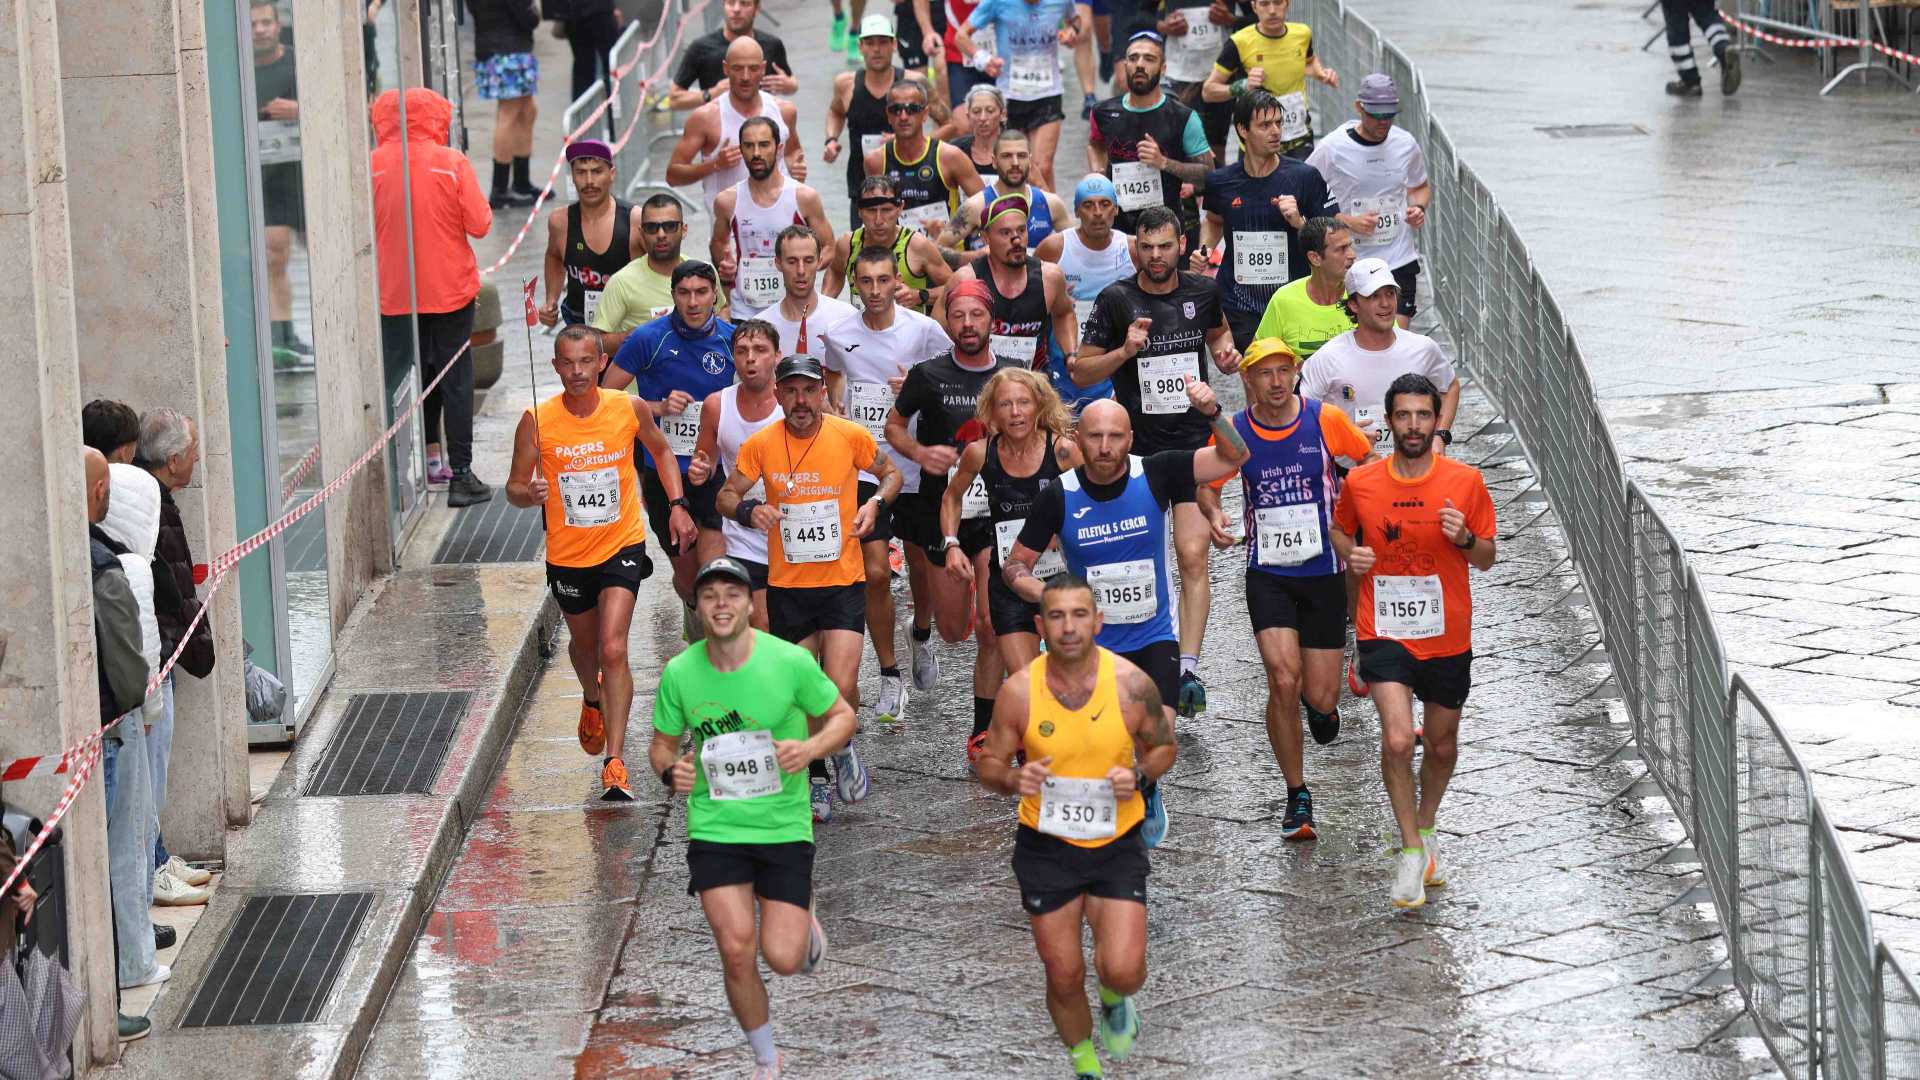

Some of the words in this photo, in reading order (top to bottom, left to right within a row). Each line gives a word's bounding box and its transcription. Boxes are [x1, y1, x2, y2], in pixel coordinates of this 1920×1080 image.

[1191, 25, 1208, 36] 451
[1123, 181, 1151, 195] 1426
[1248, 252, 1273, 266] 889
[754, 278, 779, 291] 1318
[1152, 328, 1203, 342] OLIMPIA
[1156, 377, 1185, 394] 980
[555, 441, 605, 459] PACERS
[1285, 462, 1303, 475] pub
[578, 493, 606, 508] 442
[797, 526, 826, 542] 443
[1077, 523, 1112, 541] ATLETICA
[1112, 521, 1118, 533] 5
[1120, 515, 1147, 531] CERCHI
[1274, 531, 1302, 548] 764
[1105, 586, 1141, 603] 1965
[1390, 600, 1426, 617] 1567
[1411, 628, 1434, 636] CRAFT
[715, 709, 744, 733] PHM
[725, 759, 759, 777] 948
[1062, 804, 1095, 823] 530
